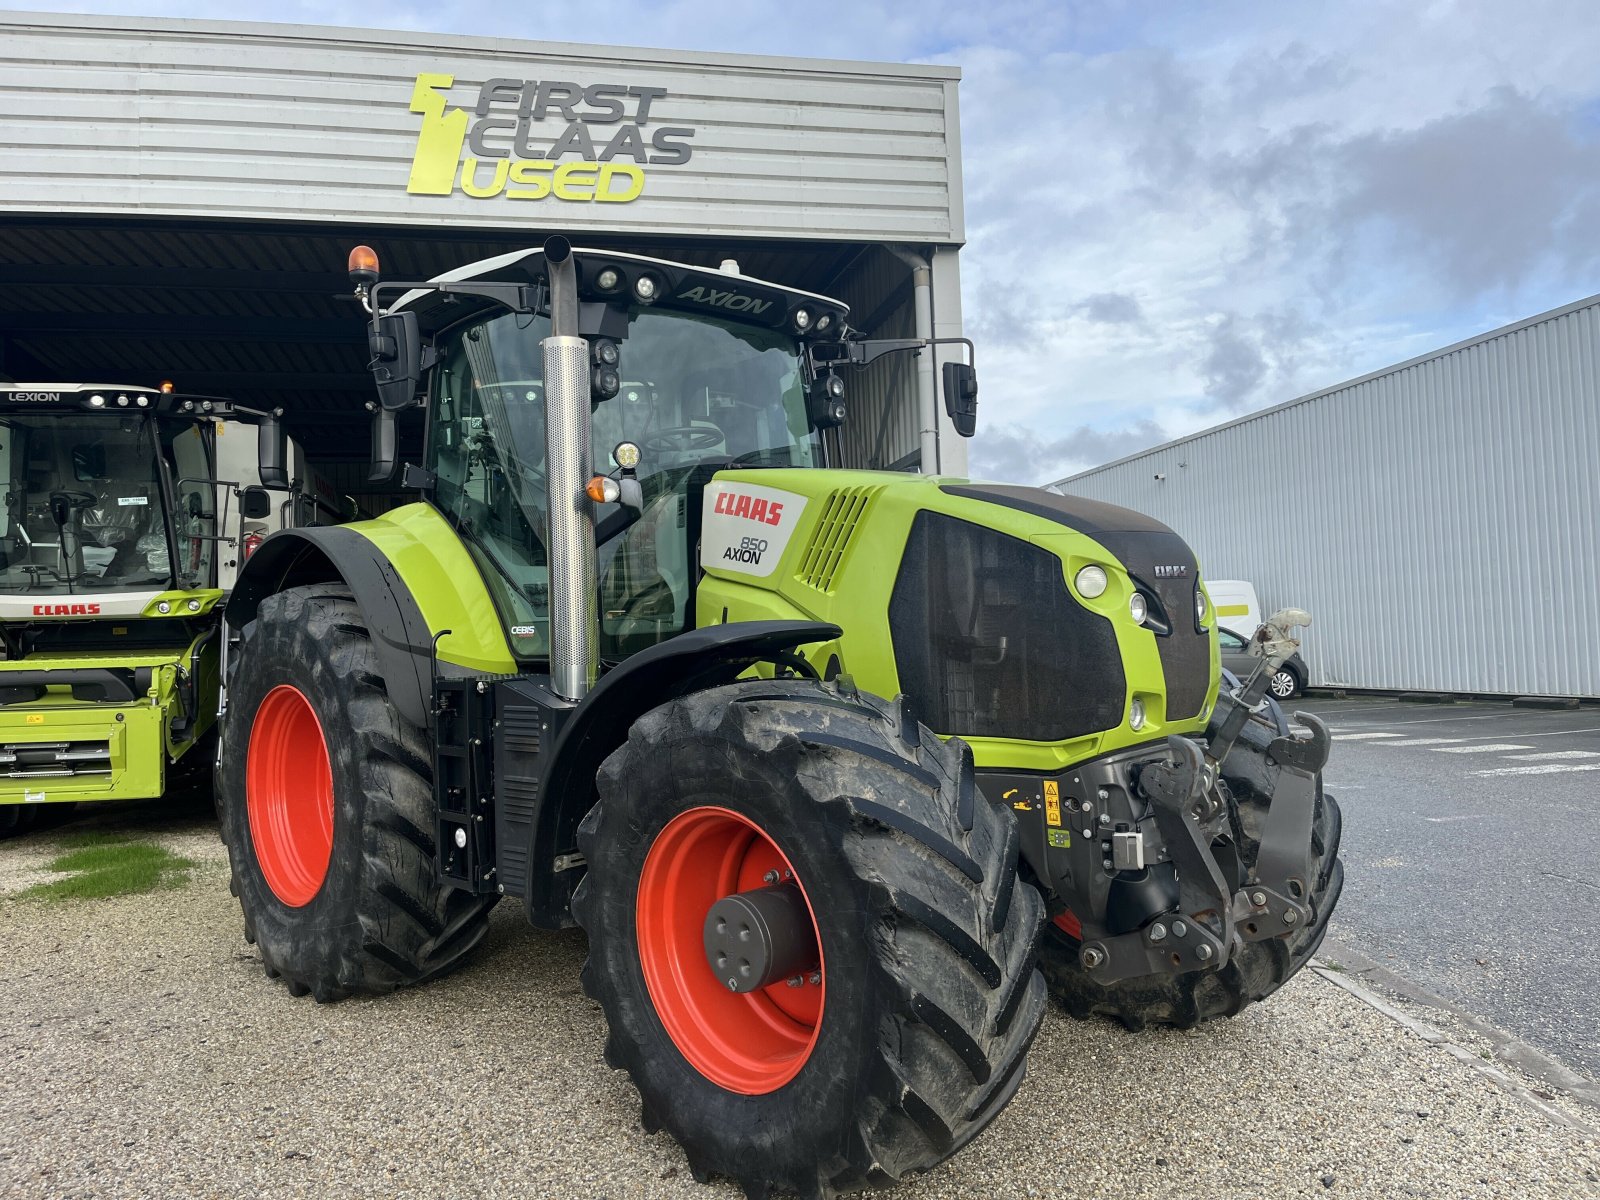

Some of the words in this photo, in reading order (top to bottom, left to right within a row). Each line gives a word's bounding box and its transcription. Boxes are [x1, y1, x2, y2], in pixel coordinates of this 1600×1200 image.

[475, 77, 668, 125] FIRST
[468, 117, 696, 165] CLAAS
[460, 157, 646, 202] USED
[677, 286, 774, 314] AXION
[8, 392, 60, 402] LEXION
[714, 492, 784, 527] CLAAS
[722, 546, 761, 565] AXION
[740, 536, 768, 553] 850
[33, 603, 101, 616] CLAAS
[511, 625, 535, 635] CEBIS
